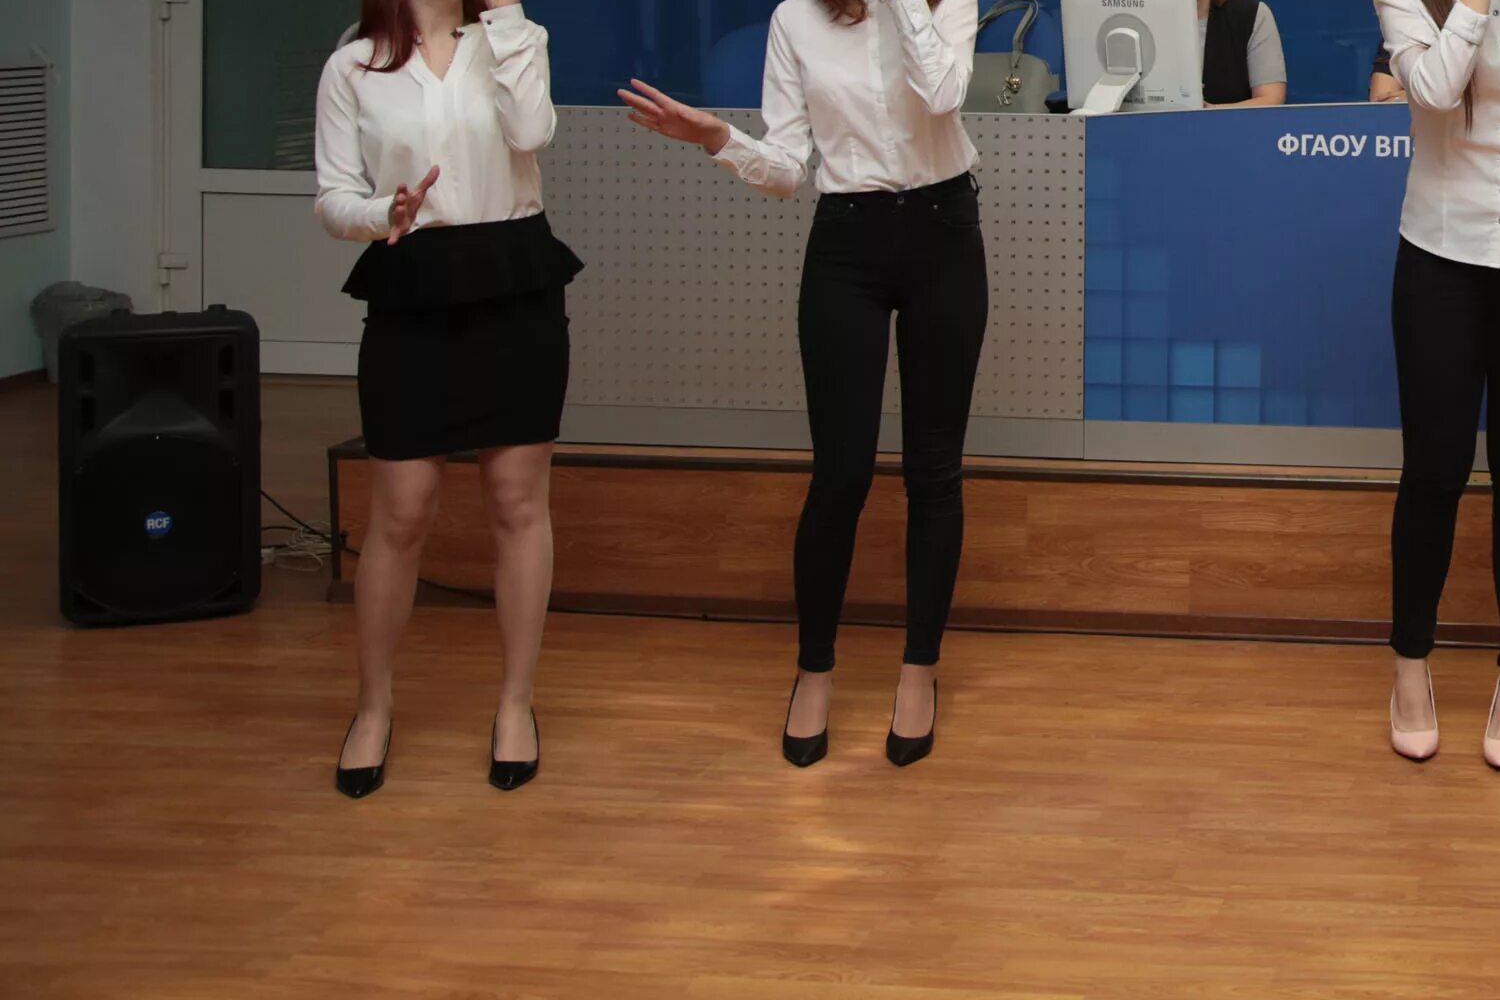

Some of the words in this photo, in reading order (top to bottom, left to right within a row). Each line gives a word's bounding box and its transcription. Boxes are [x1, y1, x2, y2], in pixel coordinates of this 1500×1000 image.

[1277, 133, 1368, 158] ФГАОУ
[1375, 135, 1416, 158] ВП
[147, 517, 170, 529] RCF
